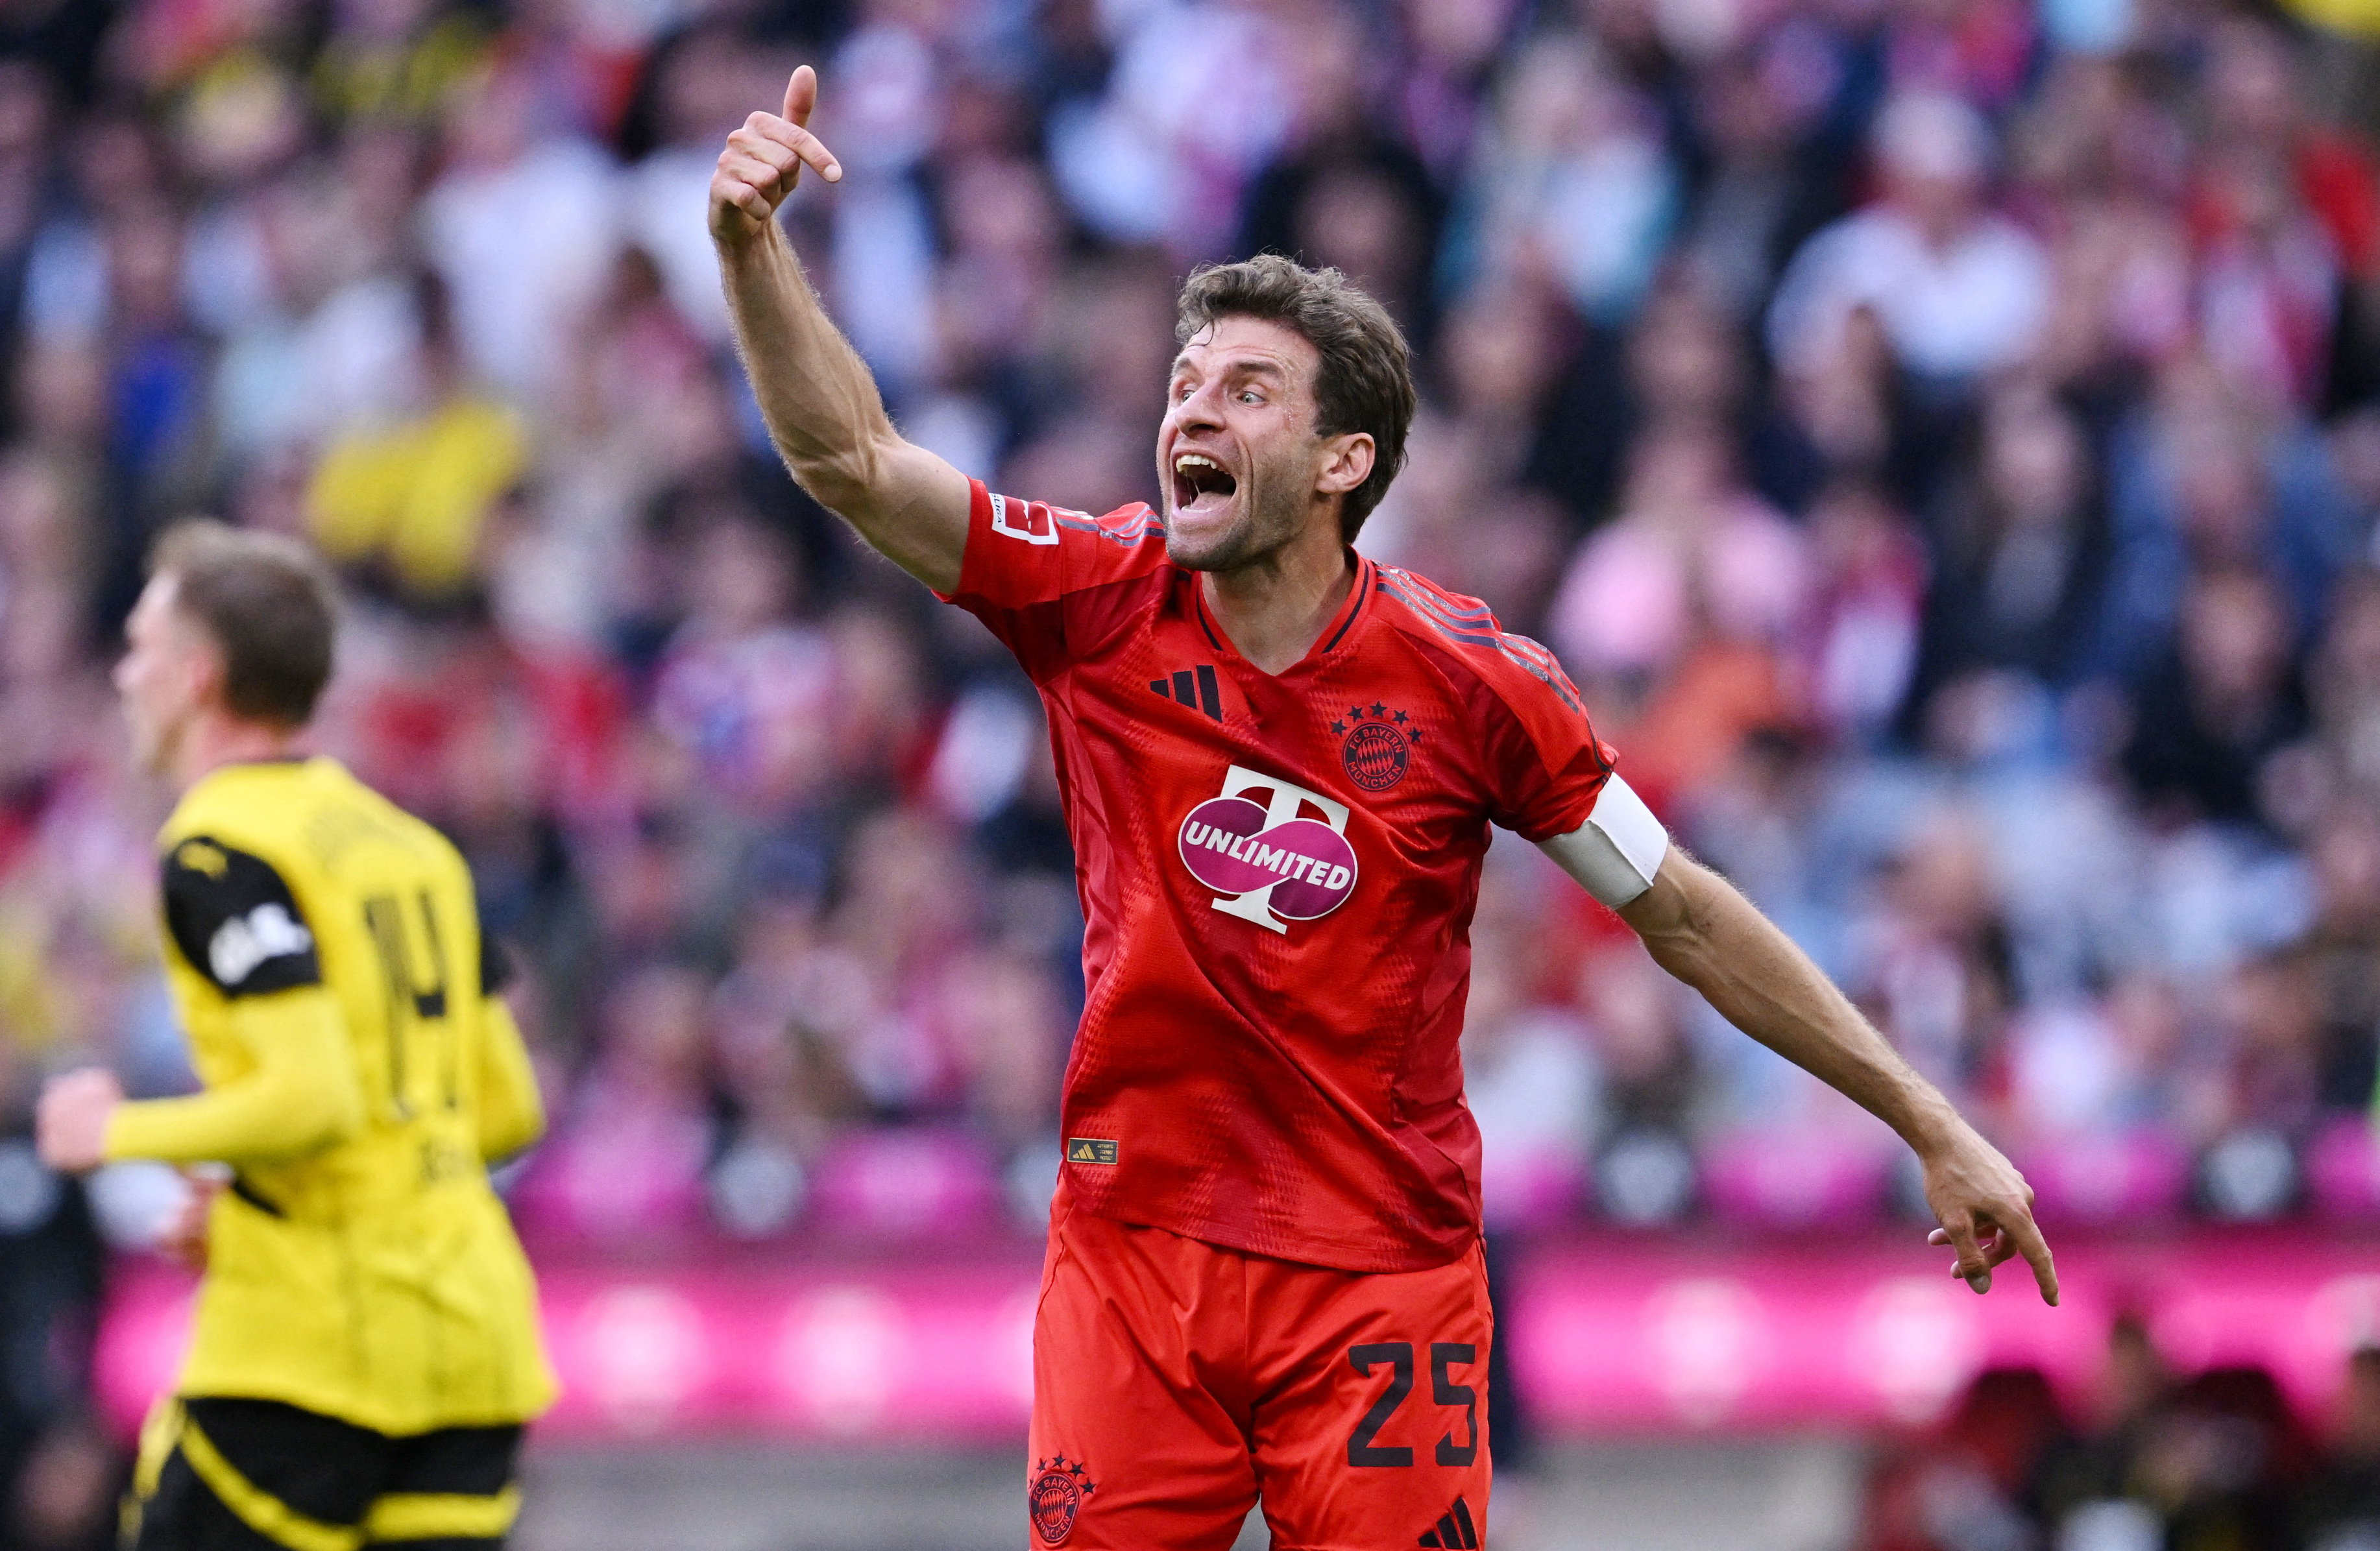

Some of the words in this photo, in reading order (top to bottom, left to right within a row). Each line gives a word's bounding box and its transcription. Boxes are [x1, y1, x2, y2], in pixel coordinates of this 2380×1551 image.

[1349, 734, 1362, 750] FC
[1362, 728, 1404, 753] BAYERN
[1185, 821, 1351, 890] UNLIMITED
[363, 889, 457, 1122] 14
[1347, 1341, 1478, 1467] 25
[1033, 1486, 1043, 1501] FC
[1043, 1477, 1076, 1505] BAYERN
